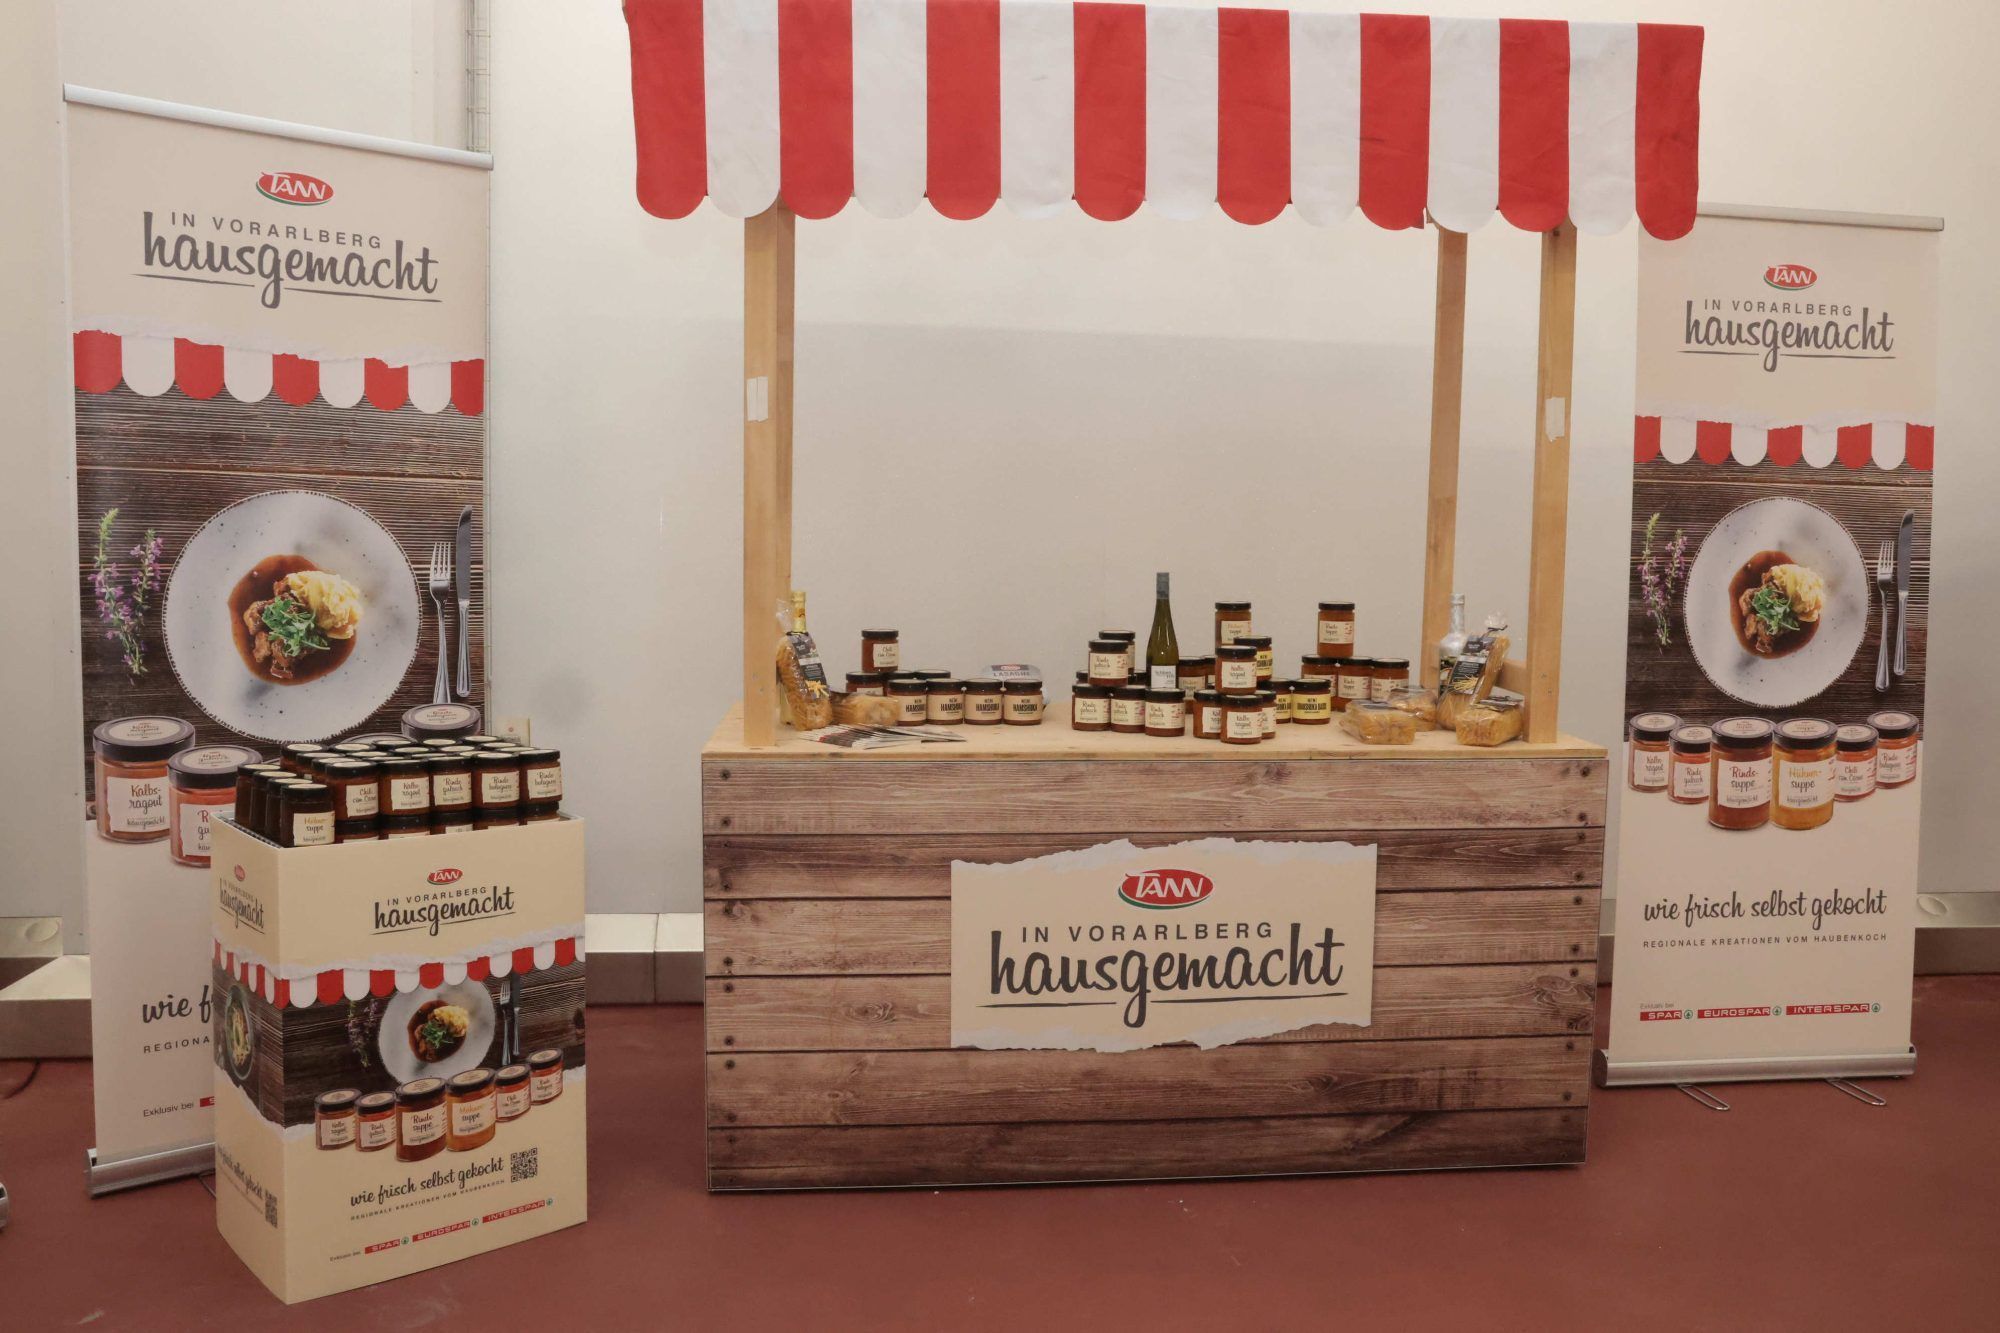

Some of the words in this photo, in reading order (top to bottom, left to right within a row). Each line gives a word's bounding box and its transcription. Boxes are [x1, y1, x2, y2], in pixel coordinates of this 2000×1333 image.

[261, 171, 326, 200] TANN
[171, 211, 196, 228] IN
[212, 216, 382, 249] VORARLBERG
[143, 211, 439, 310] hausgemacht
[1768, 264, 1812, 285] TANN
[1703, 298, 1721, 311] IN
[1732, 300, 1853, 317] VORARLBERG
[1685, 299, 1895, 373] hausgemacht
[131, 784, 161, 797] Kalbs-
[1730, 779, 1755, 792] suppe
[1790, 780, 1815, 793] suppe
[128, 796, 163, 815] ragout
[306, 825, 324, 834] suppe
[430, 869, 460, 882] TANN
[1125, 872, 1205, 899] TANN
[387, 898, 400, 907] IN
[406, 886, 488, 904] VORARLBERG
[374, 885, 516, 937] hausgemacht
[1644, 898, 1680, 921] wie
[1685, 890, 1745, 928] frisch
[1751, 889, 1806, 917] selbst
[1812, 888, 1887, 930] gekocht
[1022, 926, 1049, 943] IN
[1069, 922, 1274, 942] VORARLBERG
[1643, 938, 1706, 948] REGIONALE
[1711, 936, 1780, 946] KREATIONEN
[1786, 935, 1809, 943] VOM
[1814, 933, 1887, 943] HAUBENKOCH
[990, 922, 1345, 1028] hausgemacht
[142, 994, 193, 1024] wie
[1648, 1010, 1682, 1020] SPAR
[1703, 1007, 1770, 1018] EUROSPAR
[1793, 1004, 1869, 1014] INTERSPAR
[143, 1035, 210, 1054] REGIONA
[143, 1103, 179, 1117] Exklusiv
[181, 1102, 194, 1110] bei
[461, 1111, 480, 1124] suppe
[350, 1190, 376, 1207] wie
[377, 1177, 417, 1205] frisch
[420, 1168, 456, 1190] selbst
[458, 1156, 504, 1190] gekocht
[372, 1240, 400, 1252] SPAR
[417, 1221, 471, 1241] EUROSPAR
[488, 1200, 546, 1222] INTERSPAR
